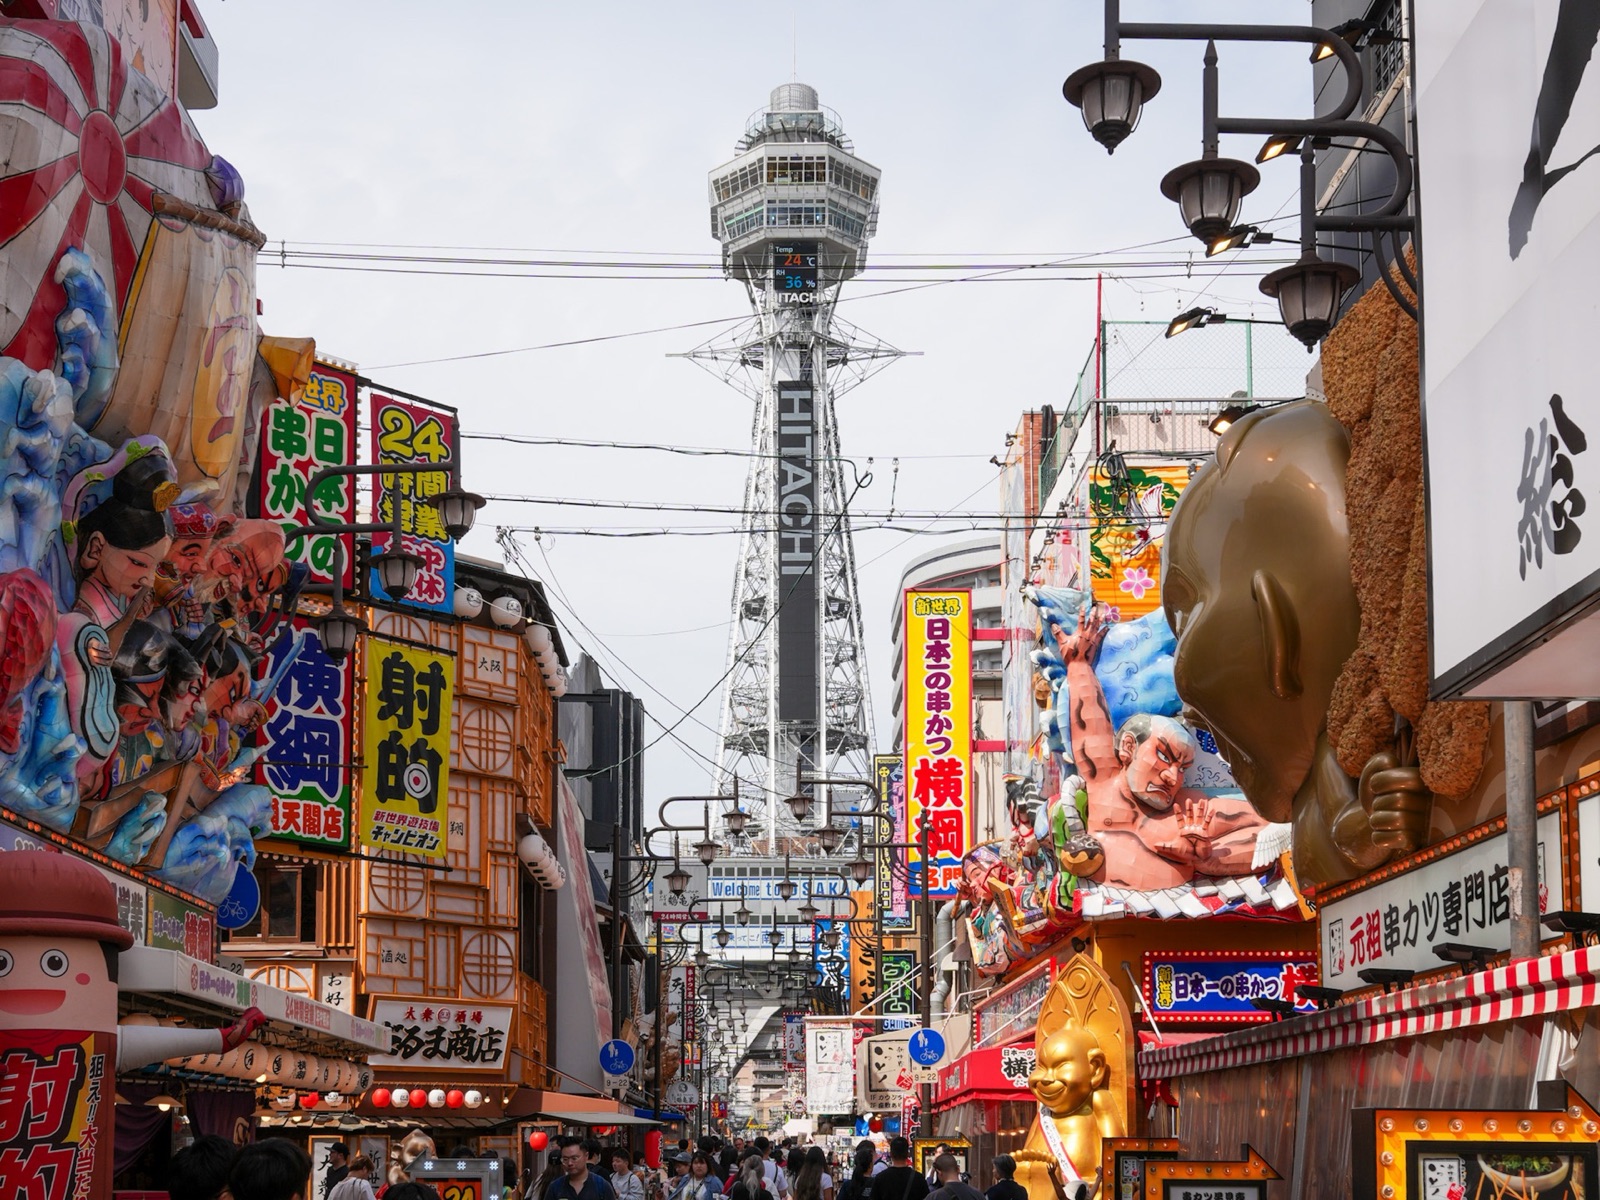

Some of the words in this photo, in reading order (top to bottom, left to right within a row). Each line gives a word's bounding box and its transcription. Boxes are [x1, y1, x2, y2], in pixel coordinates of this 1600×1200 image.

[775, 246, 793, 254] Temp
[784, 254, 802, 266] 24
[785, 276, 802, 288] 36
[378, 407, 451, 465] 24
[380, 456, 448, 500] 時間
[780, 390, 813, 576] HITACHI
[914, 597, 961, 616] 新世界
[478, 656, 503, 675] 大阪
[924, 617, 953, 756] 日本一の串かつ
[265, 626, 343, 799] 横綱
[374, 651, 447, 814] 射的
[372, 809, 441, 833] 新世界遊技場
[913, 757, 965, 860] 横綱
[371, 825, 441, 852] チャンピオン
[712, 882, 760, 896] Welcome
[766, 882, 780, 896] to
[1350, 863, 1511, 968] 元祖串カツ専門店
[380, 948, 408, 965] 酒処
[1156, 966, 1173, 1008] 新世界
[1174, 974, 1280, 1001] 日本一の串かつ
[404, 1006, 435, 1023] 大衆
[454, 1009, 484, 1025] 酒場
